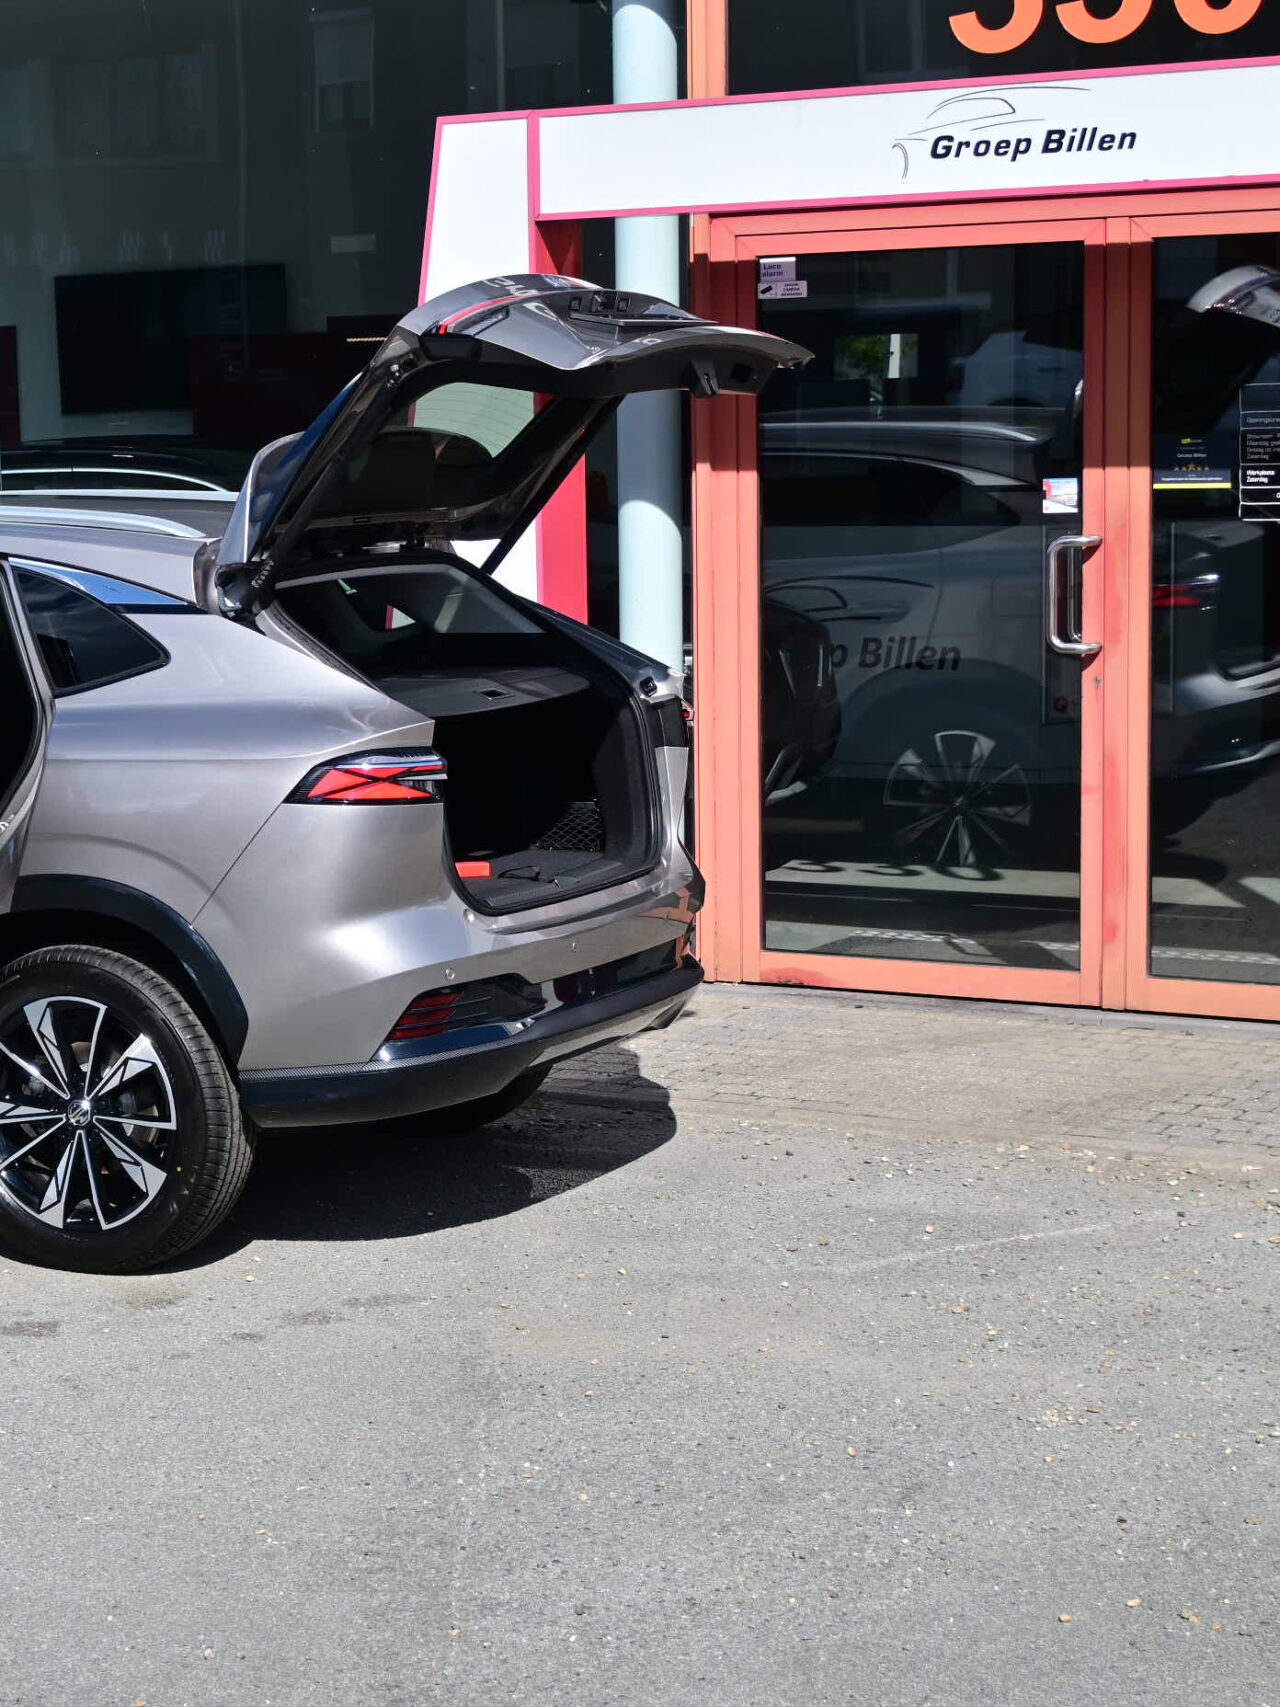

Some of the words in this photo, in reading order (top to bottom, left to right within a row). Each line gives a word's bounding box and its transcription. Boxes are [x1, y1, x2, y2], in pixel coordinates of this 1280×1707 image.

[930, 134, 1032, 162] Groep
[1041, 126, 1137, 154] Billen
[858, 636, 961, 671] Billen
